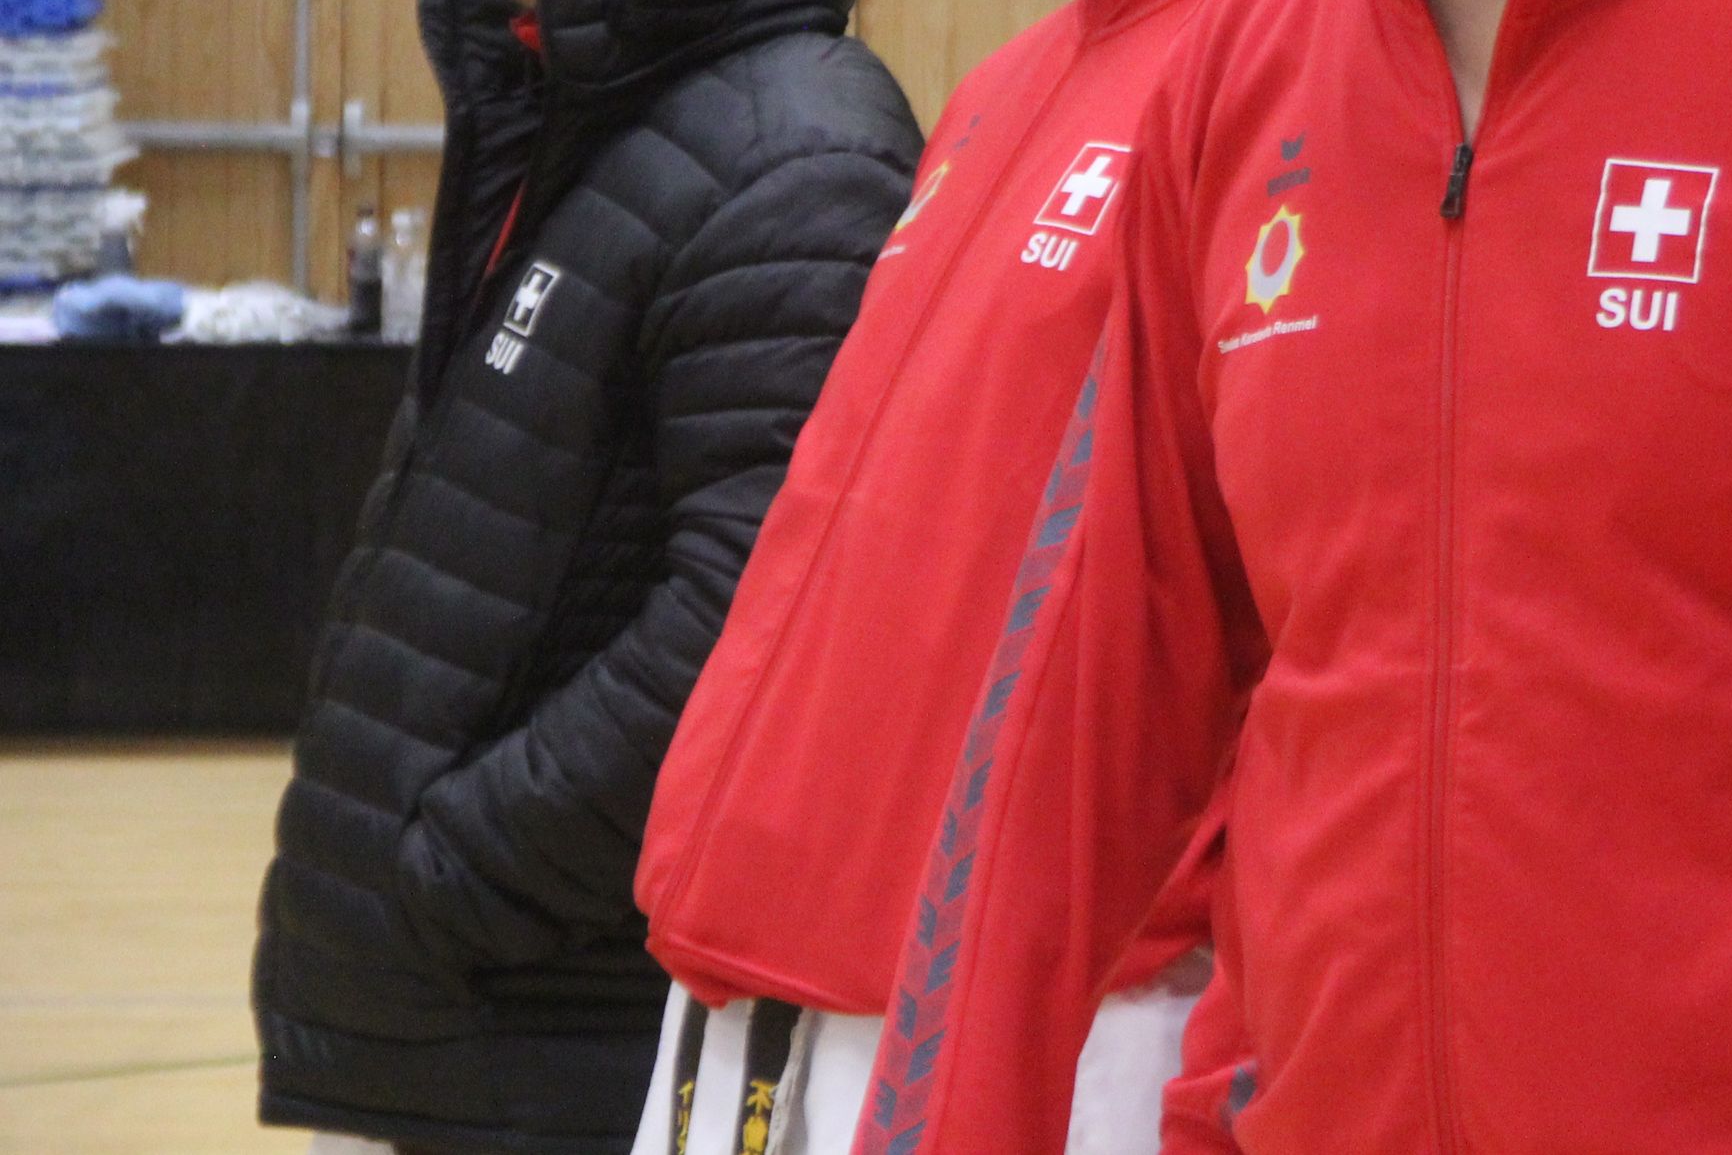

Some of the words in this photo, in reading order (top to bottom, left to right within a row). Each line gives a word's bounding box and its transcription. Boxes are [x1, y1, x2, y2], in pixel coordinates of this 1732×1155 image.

[1020, 231, 1078, 272] SUI
[1595, 287, 1679, 332] SUI
[485, 331, 525, 375] SUI
